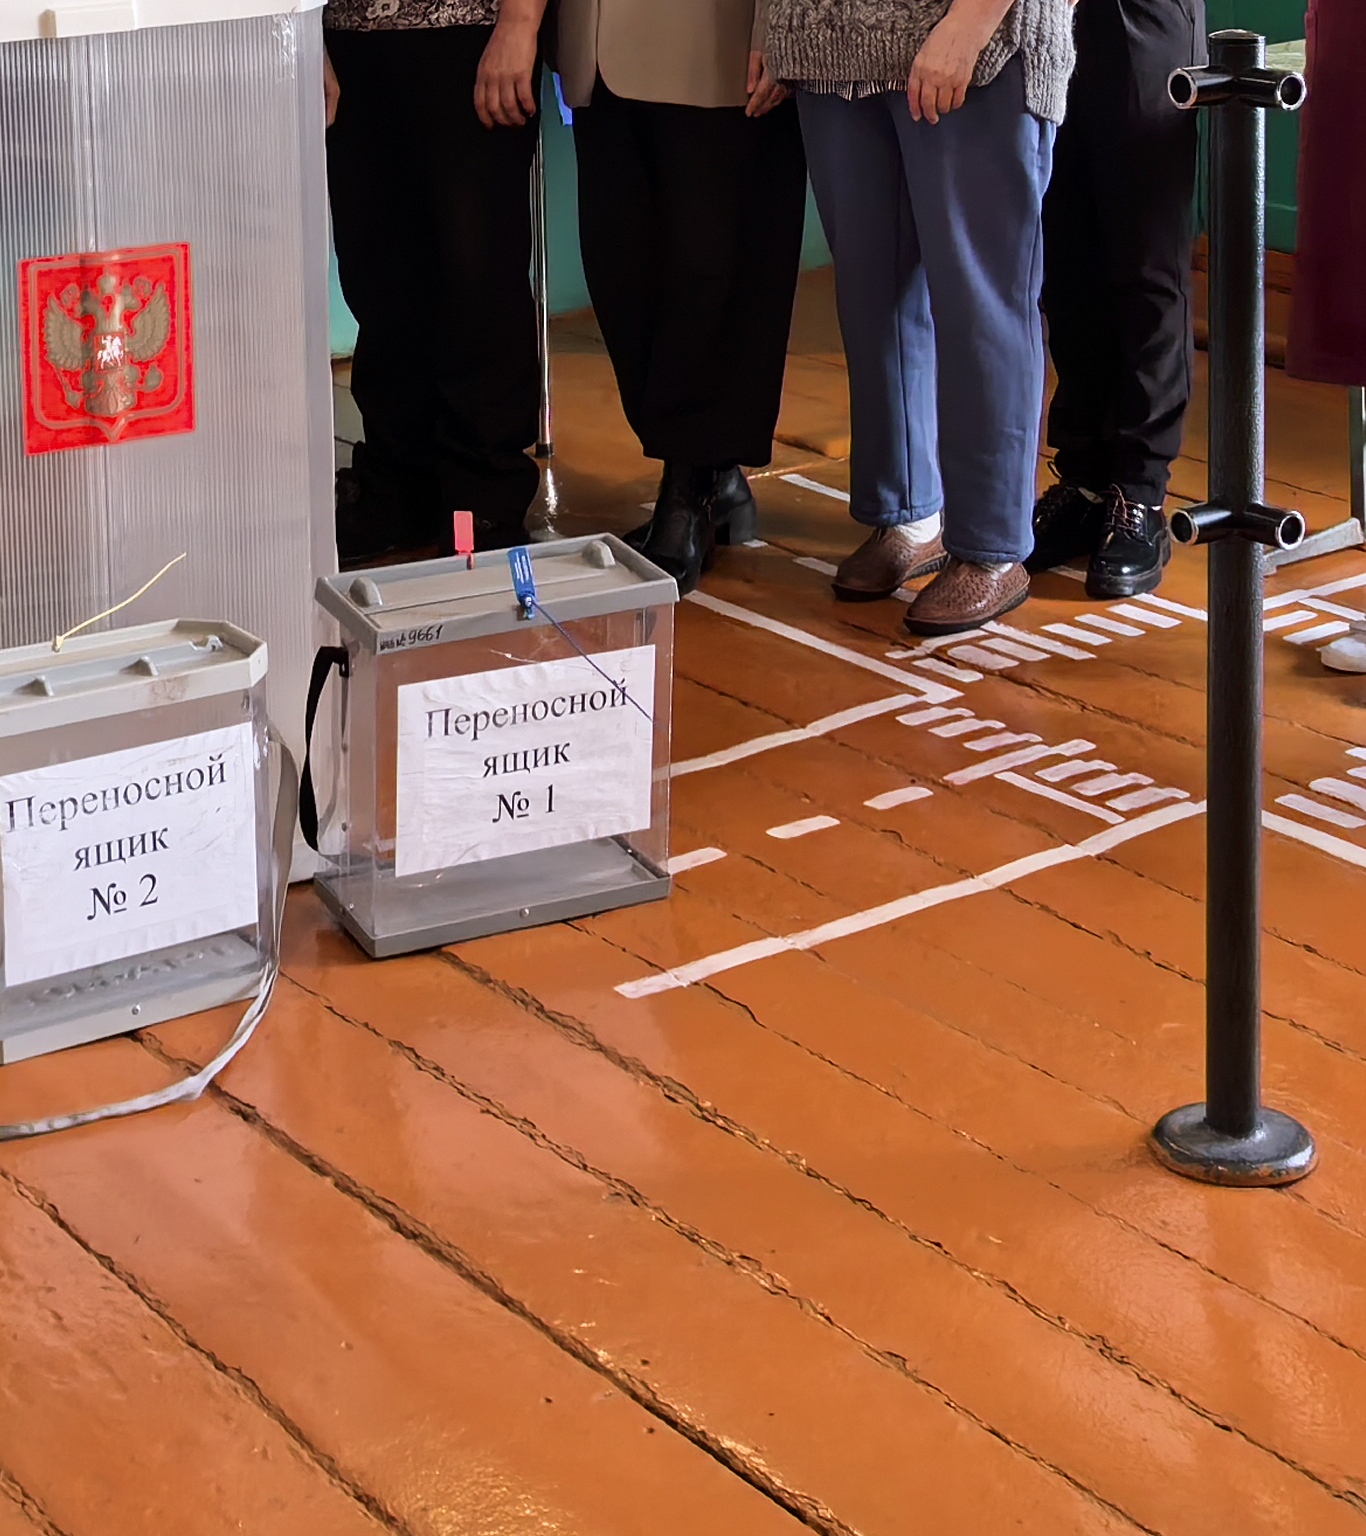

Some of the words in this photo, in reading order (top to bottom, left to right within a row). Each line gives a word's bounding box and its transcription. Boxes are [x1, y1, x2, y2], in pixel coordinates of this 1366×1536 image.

[424, 678, 628, 741] Переносной
[482, 742, 571, 778] ящик
[5, 753, 227, 834] Переносной
[492, 790, 530, 823] №
[545, 784, 556, 813] 1
[73, 827, 170, 872] ящик
[86, 882, 127, 921] №
[139, 873, 159, 907] 2
